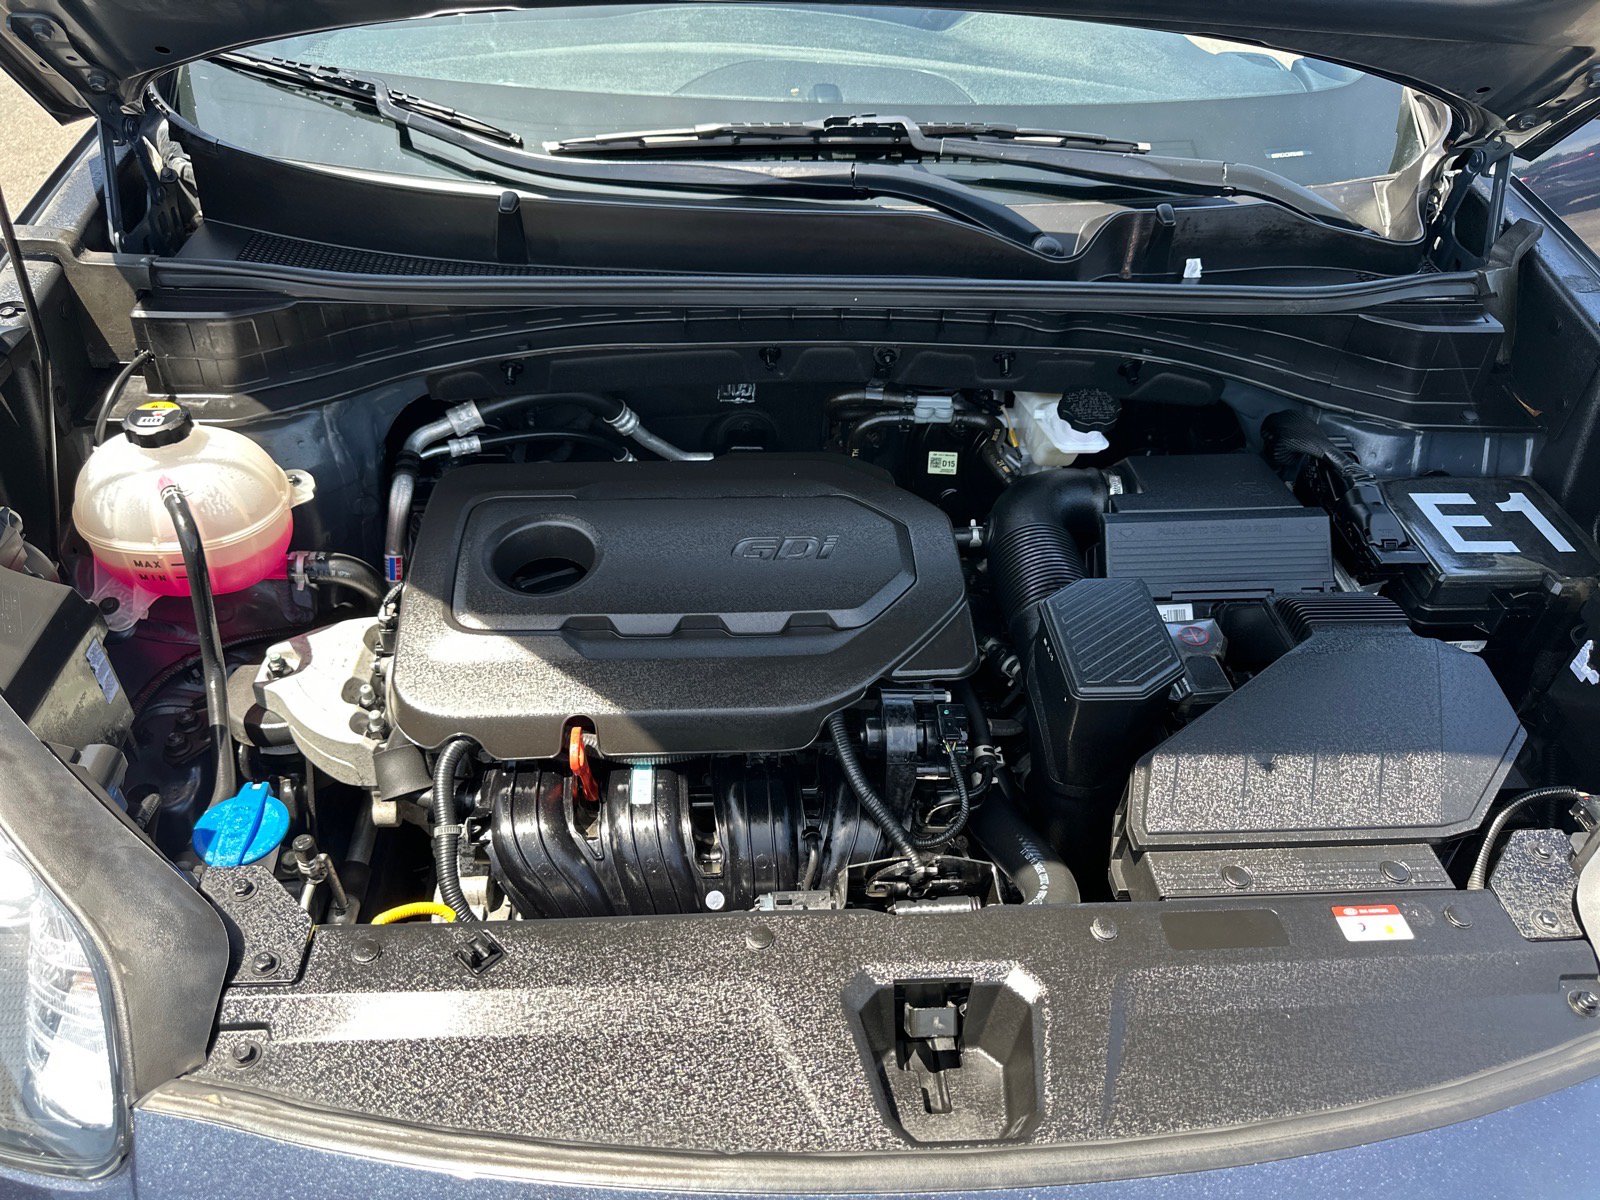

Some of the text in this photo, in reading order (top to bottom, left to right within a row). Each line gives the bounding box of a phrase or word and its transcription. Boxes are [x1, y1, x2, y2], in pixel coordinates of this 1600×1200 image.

[942, 460, 955, 468] D15
[1408, 493, 1576, 553] E1
[133, 559, 162, 569] MAX
[139, 573, 167, 582] MIN
